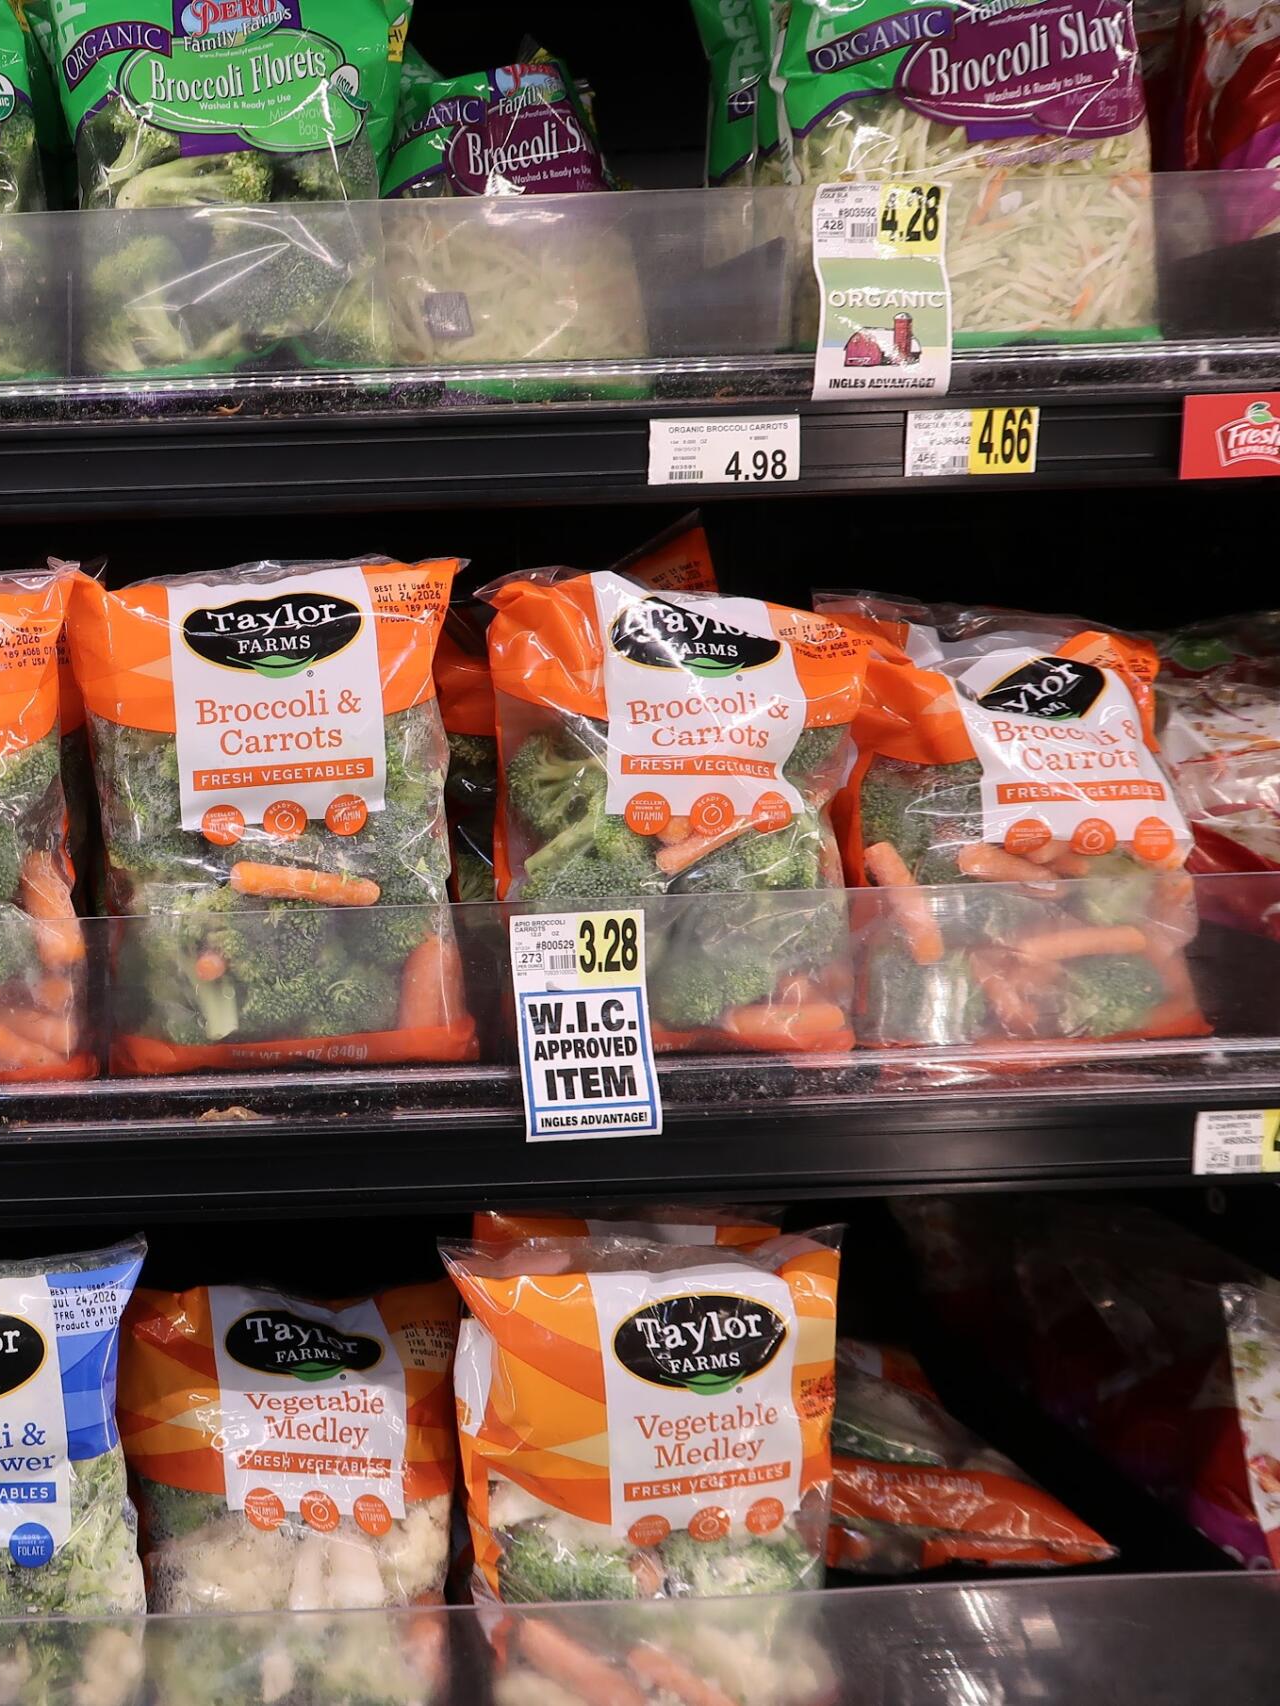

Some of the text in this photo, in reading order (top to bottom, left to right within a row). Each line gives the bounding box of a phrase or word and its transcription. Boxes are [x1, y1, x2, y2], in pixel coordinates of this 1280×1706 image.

[184, 7, 292, 53] Family Farms
[815, 10, 946, 71] ORGANIC
[65, 27, 162, 81] ORGANIC
[929, 12, 1125, 96] Broccoli Slaw
[150, 49, 326, 102] Broccoli Florets
[199, 94, 291, 112] Washed & Ready to Use
[298, 119, 319, 139] Bag
[881, 186, 941, 242] 4.28
[828, 289, 945, 309] ORGANIC
[829, 378, 865, 388] INGLES
[978, 408, 1032, 464] 4.66
[1227, 423, 1280, 448] Fresh
[725, 450, 787, 480] 4.98
[374, 584, 392, 592] BEST
[377, 590, 440, 602] Jul 24,2026
[206, 603, 337, 636] Taylor
[238, 635, 311, 654] FARMS
[195, 689, 361, 725] Broccoli &
[626, 692, 756, 724] Broccoli
[220, 725, 343, 756] Carrots
[201, 762, 366, 786] FRESH VEGETABLES
[629, 760, 769, 776] FRESH VEGETABLES
[632, 811, 663, 821] VITAMIN
[644, 822, 650, 831] A
[536, 940, 575, 950] #800529
[580, 918, 637, 973] 3.28
[518, 953, 542, 963] .273
[528, 999, 636, 1035] W.I.C.
[534, 1036, 637, 1061] APPROVED
[545, 1065, 638, 1101] ITEM
[541, 1112, 647, 1128] INGLES ADVANTAGE!
[53, 1291, 116, 1308] Jul 24,2026
[54, 1308, 95, 1320] TFRG 189
[246, 1318, 358, 1354] Taylor
[636, 1311, 762, 1354] Taylor
[275, 1349, 341, 1363] FARMS
[670, 1352, 740, 1373] FARMS
[244, 1389, 384, 1414] Vegetable
[22, 1423, 46, 1445] &
[264, 1416, 369, 1449] Medley
[633, 1404, 778, 1441] Vegetable
[654, 1439, 764, 1469] Medley
[632, 1483, 681, 1497] FRESH
[17, 1546, 45, 1555] FOLATE
